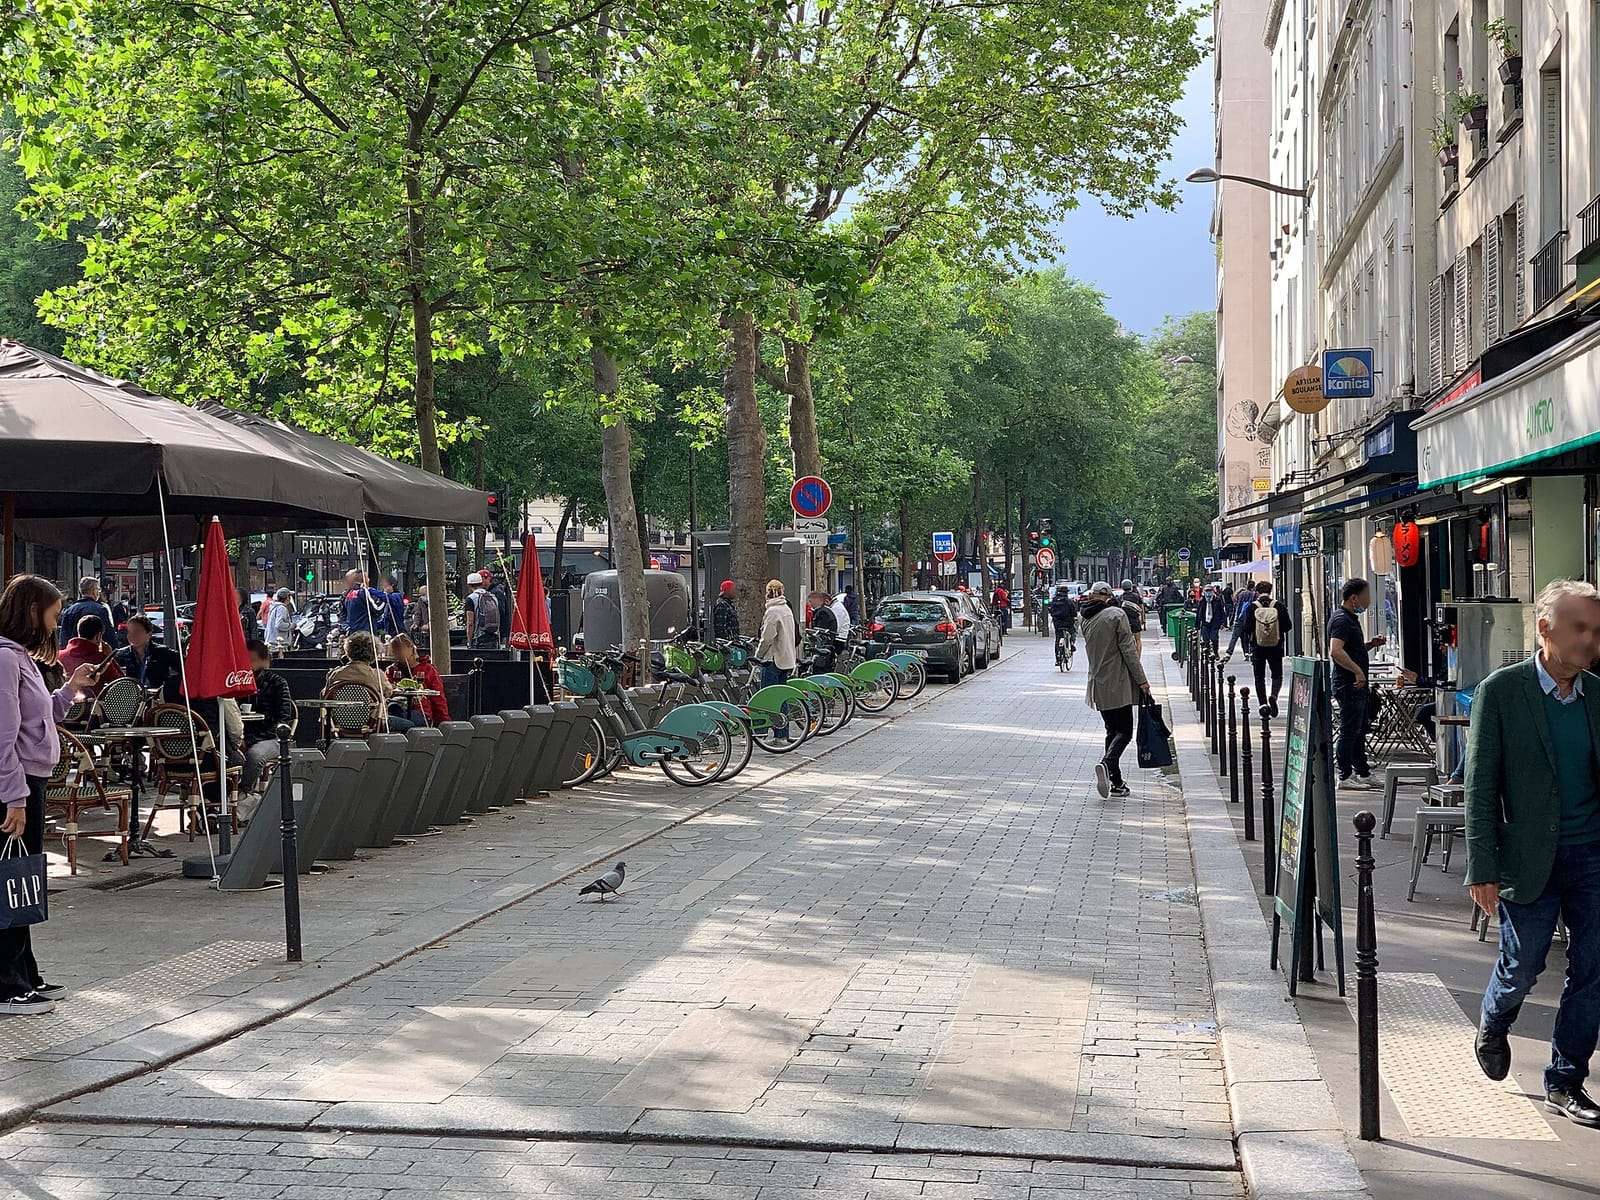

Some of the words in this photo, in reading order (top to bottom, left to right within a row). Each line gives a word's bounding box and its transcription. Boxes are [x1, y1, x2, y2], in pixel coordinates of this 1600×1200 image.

[1295, 377, 1320, 386] ARTISAN
[1327, 378, 1370, 390] Konica
[1292, 384, 1322, 395] BOULANGE
[301, 540, 367, 556] PHARMAIE
[6, 874, 41, 909] GAP
